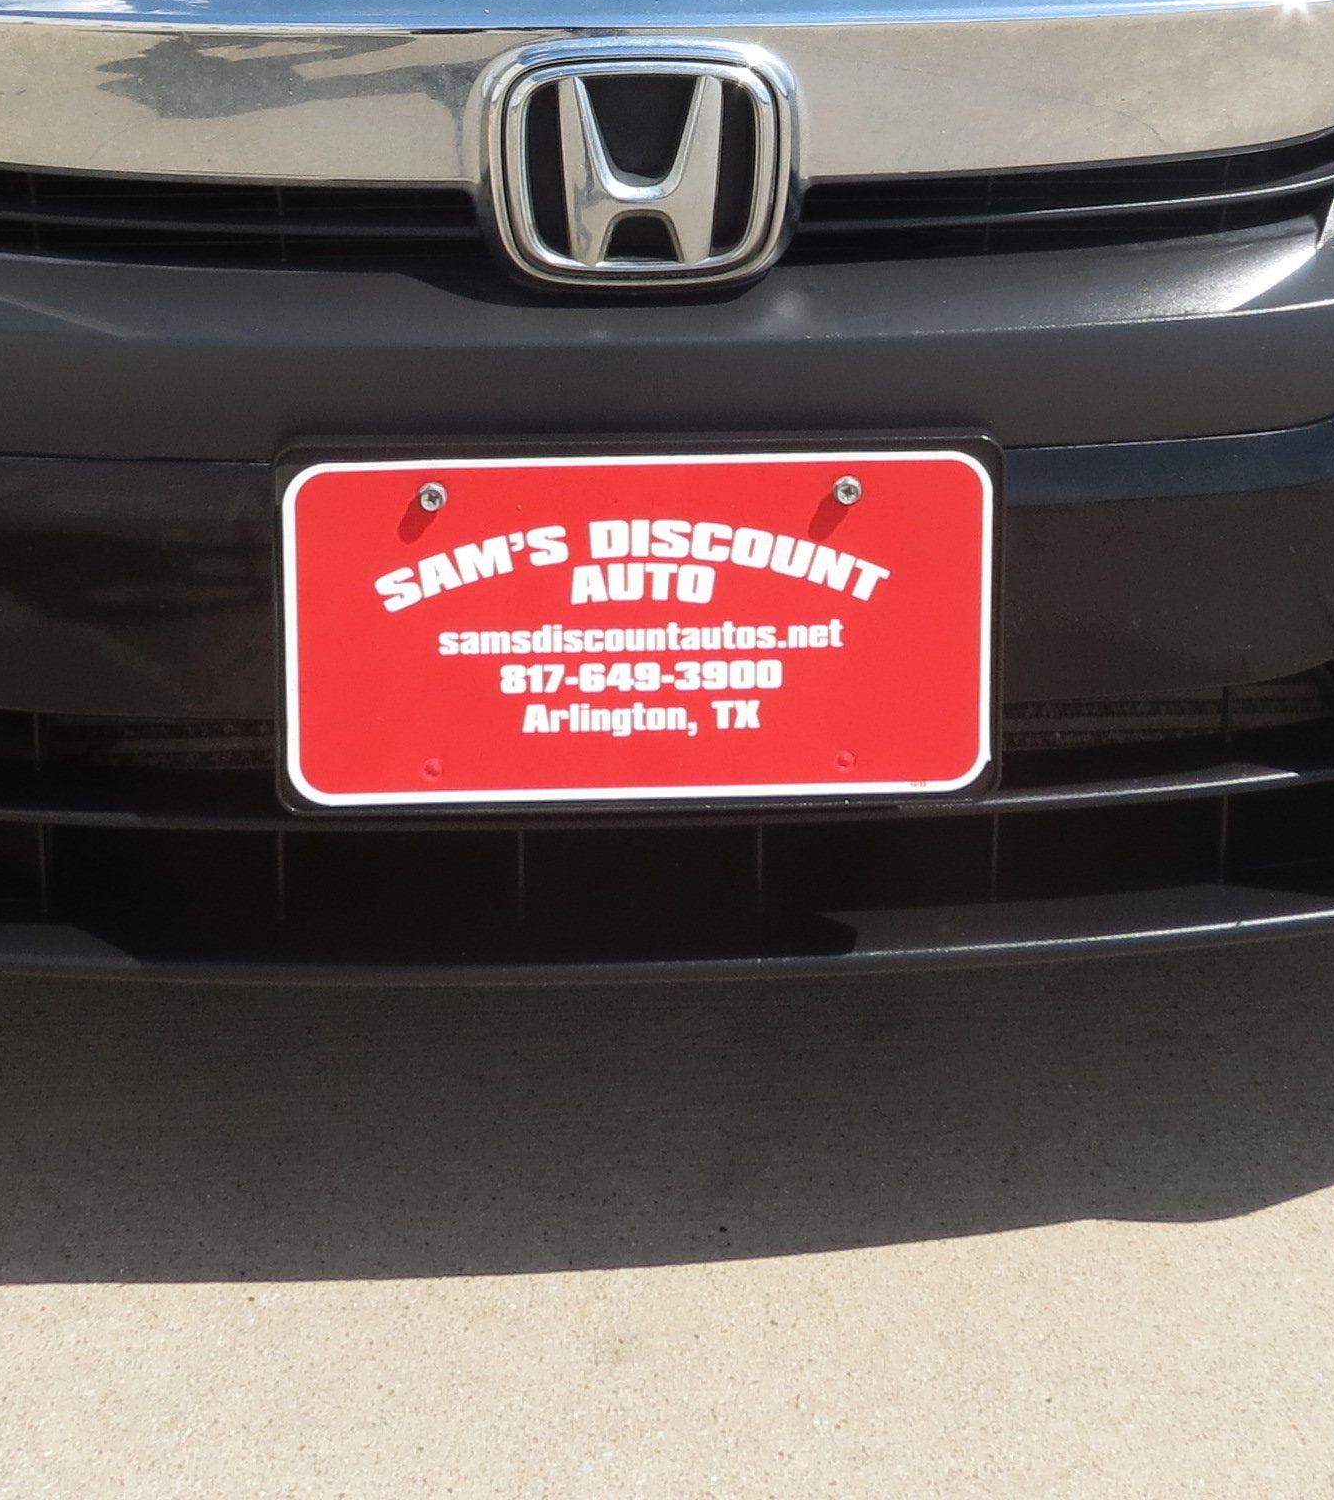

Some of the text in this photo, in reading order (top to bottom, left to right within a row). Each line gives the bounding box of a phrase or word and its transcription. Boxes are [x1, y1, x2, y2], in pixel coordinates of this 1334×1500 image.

[374, 519, 891, 613] SAM'S DISCOUNT
[570, 562, 716, 605] AUTO
[438, 618, 844, 656] samsdiscountautos.net
[500, 659, 783, 694] 817-649-3900
[522, 699, 761, 737] Arlington, TX
